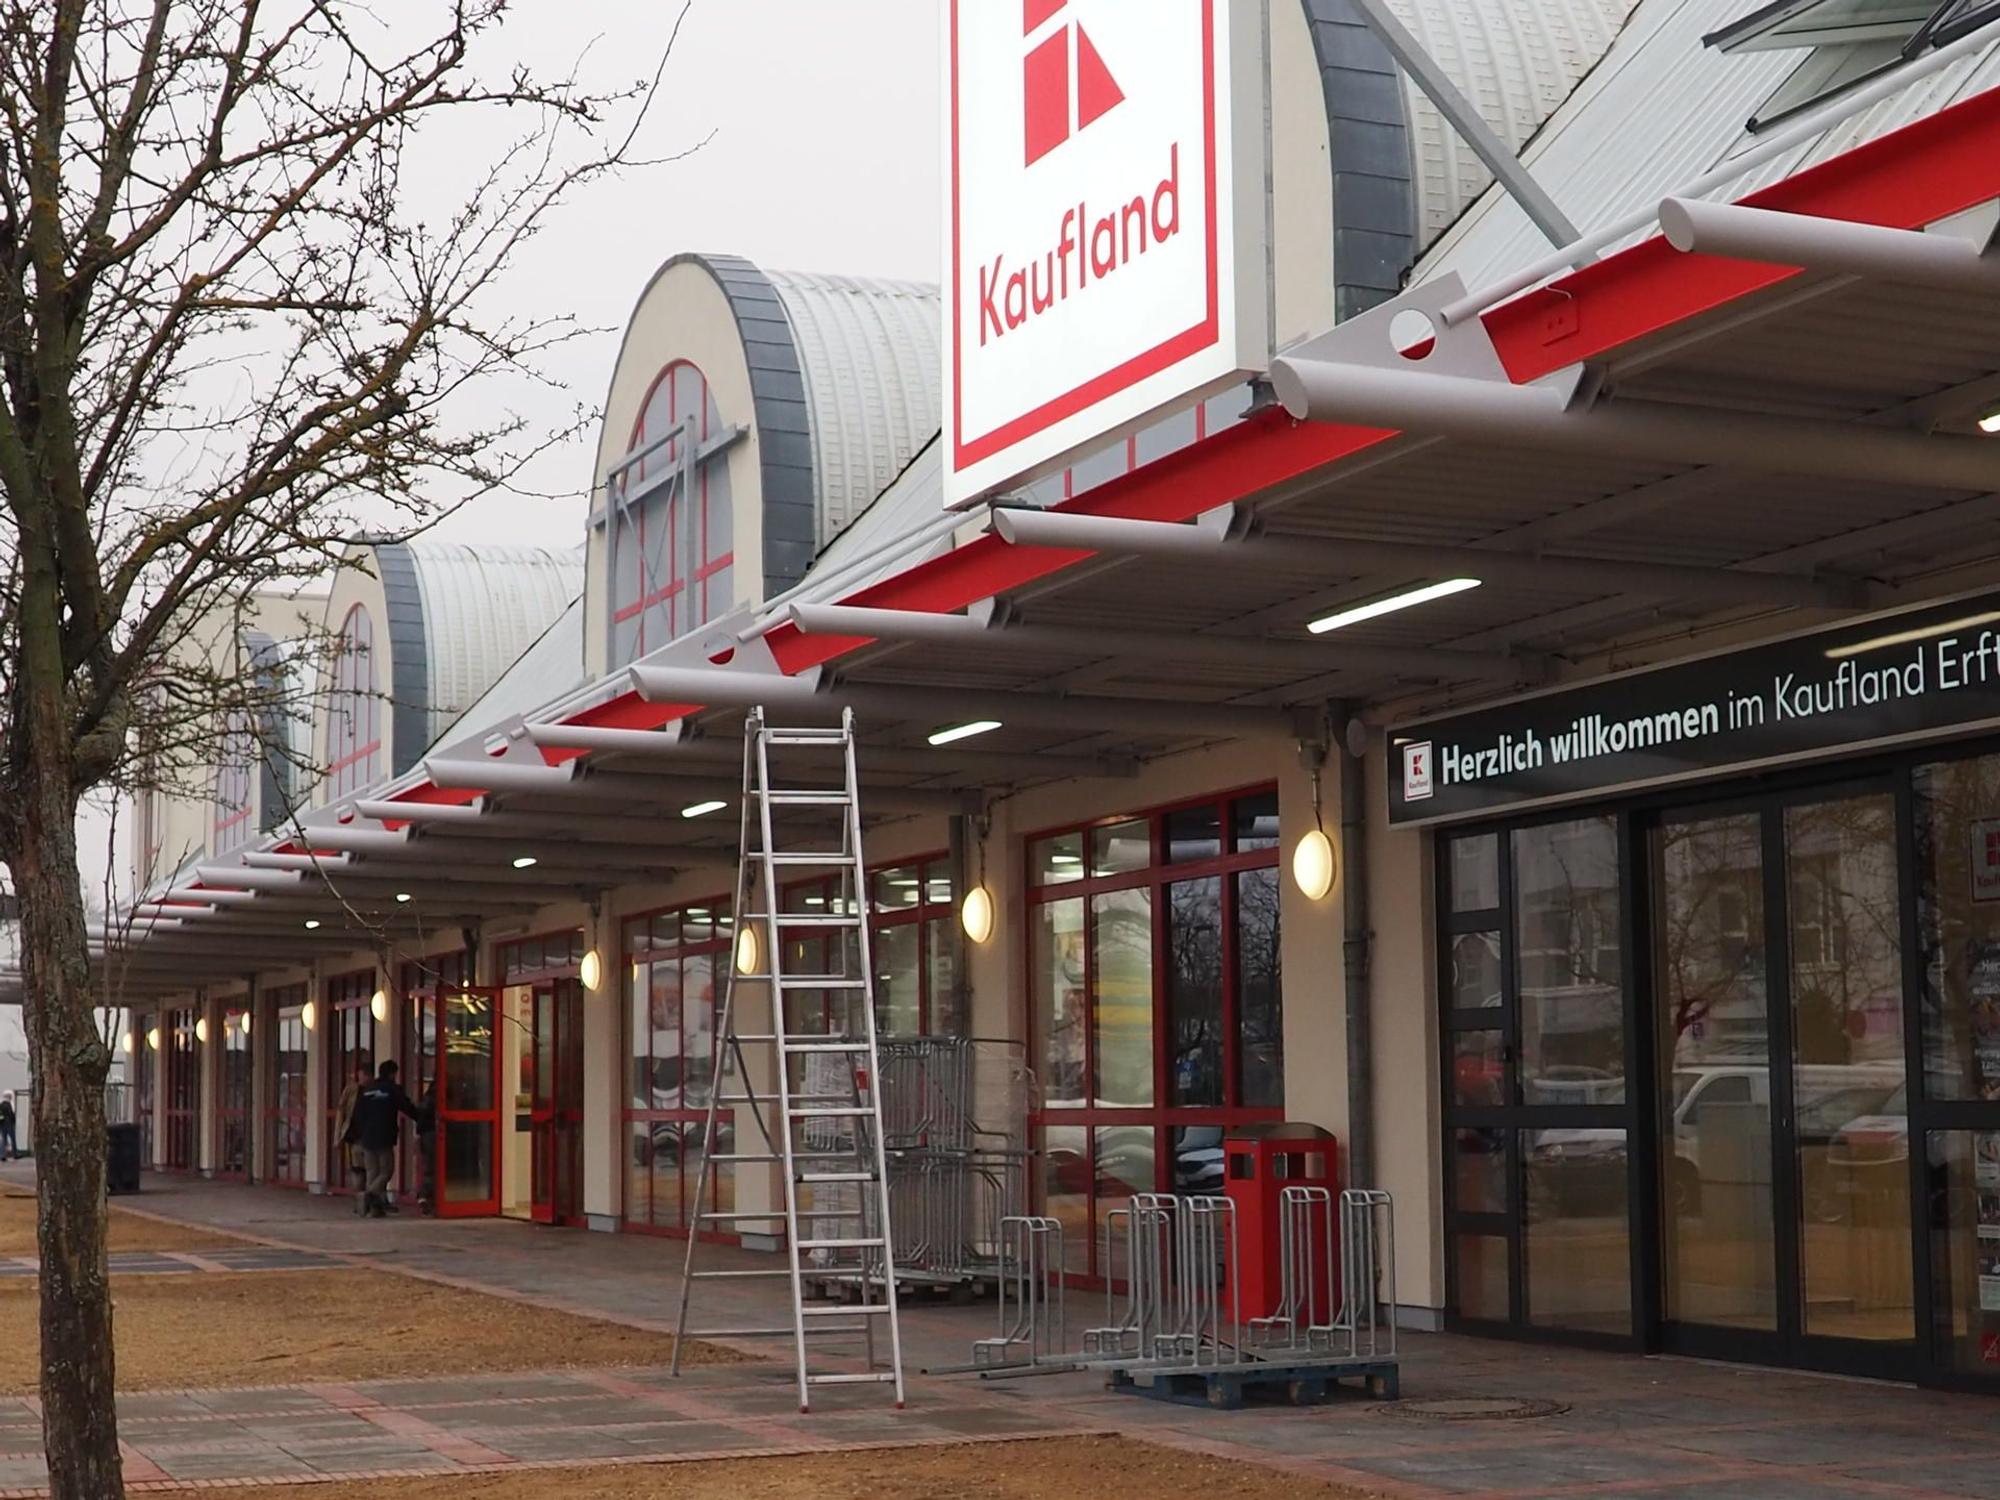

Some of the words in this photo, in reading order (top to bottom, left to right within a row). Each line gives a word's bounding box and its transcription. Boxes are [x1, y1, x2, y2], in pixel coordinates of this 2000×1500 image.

[979, 140, 1180, 348] Kaufland
[1441, 728, 1543, 786] Herzlich
[1549, 702, 1720, 764] willkommen
[1728, 691, 1765, 731] im
[1774, 645, 1925, 722] Kaufland
